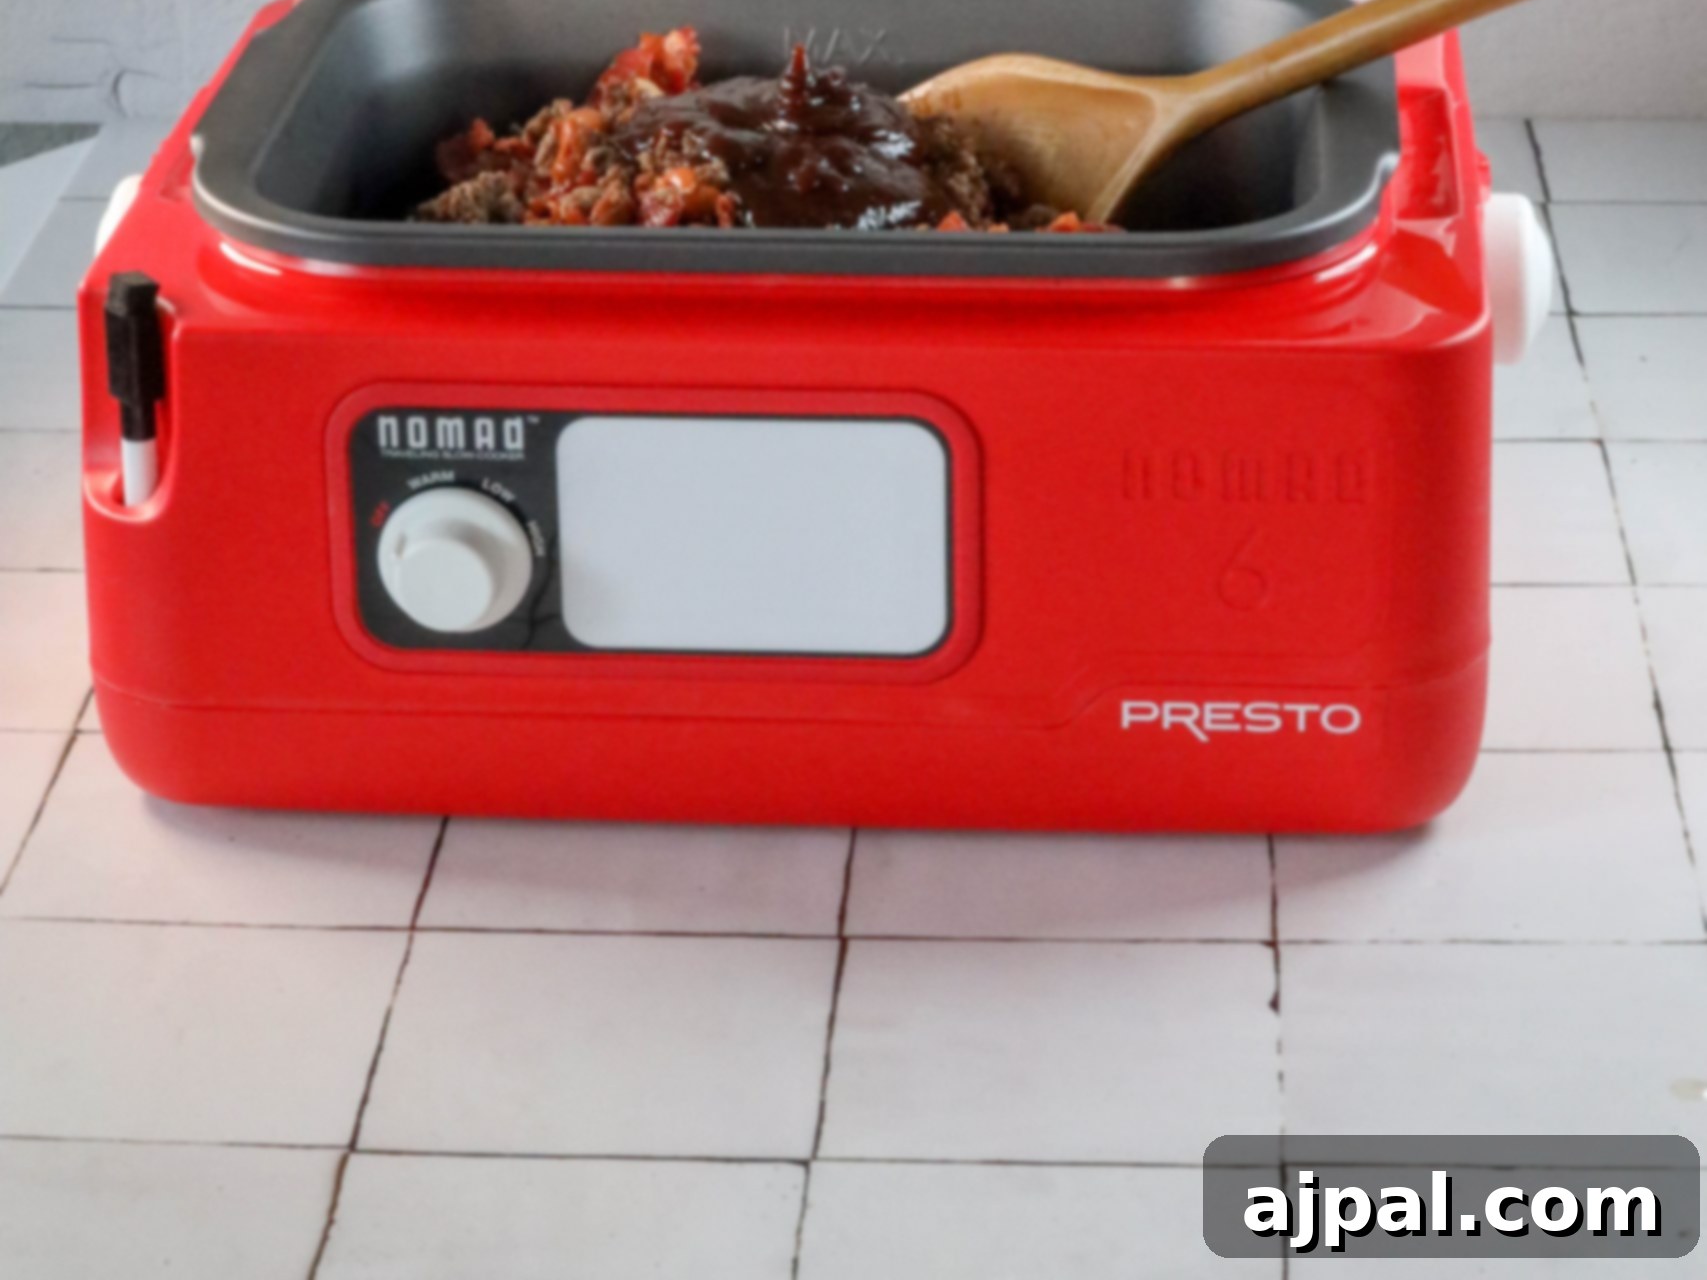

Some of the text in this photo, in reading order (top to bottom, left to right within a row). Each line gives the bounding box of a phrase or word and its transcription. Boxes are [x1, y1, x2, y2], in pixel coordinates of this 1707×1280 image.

[407, 470, 454, 490] WARM
[481, 477, 515, 502] LOW
[1120, 700, 1361, 742] PRESTO
